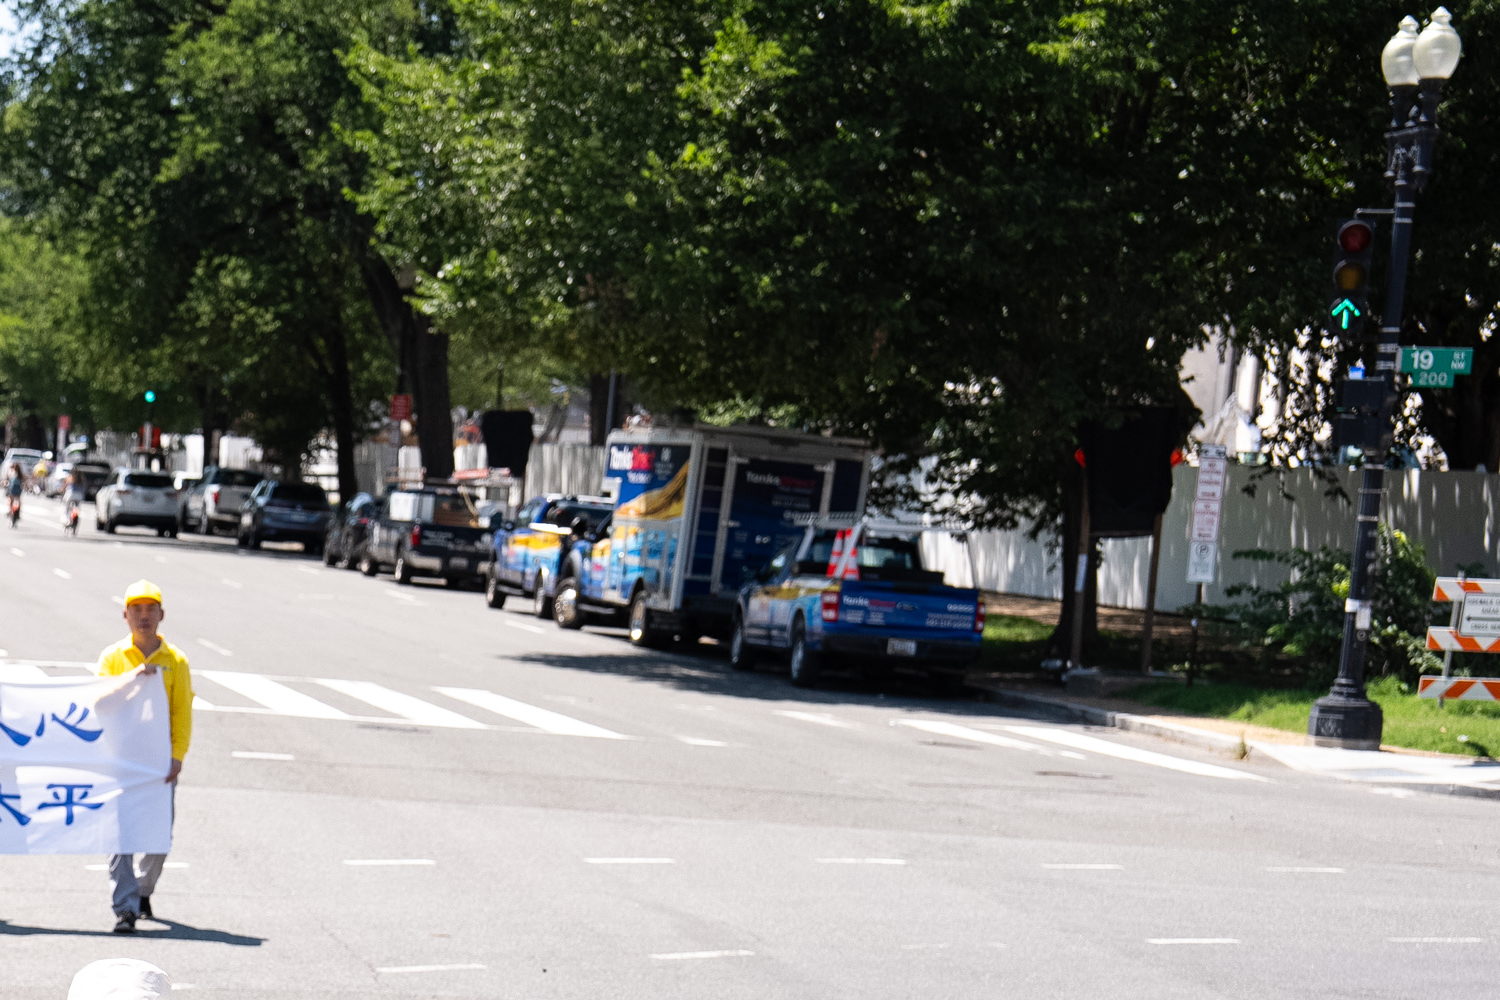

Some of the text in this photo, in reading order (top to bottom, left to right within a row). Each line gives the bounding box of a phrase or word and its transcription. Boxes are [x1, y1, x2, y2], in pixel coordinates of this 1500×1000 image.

[1411, 350, 1434, 370] 19
[1451, 360, 1466, 370] NW
[1419, 371, 1447, 386] 200
